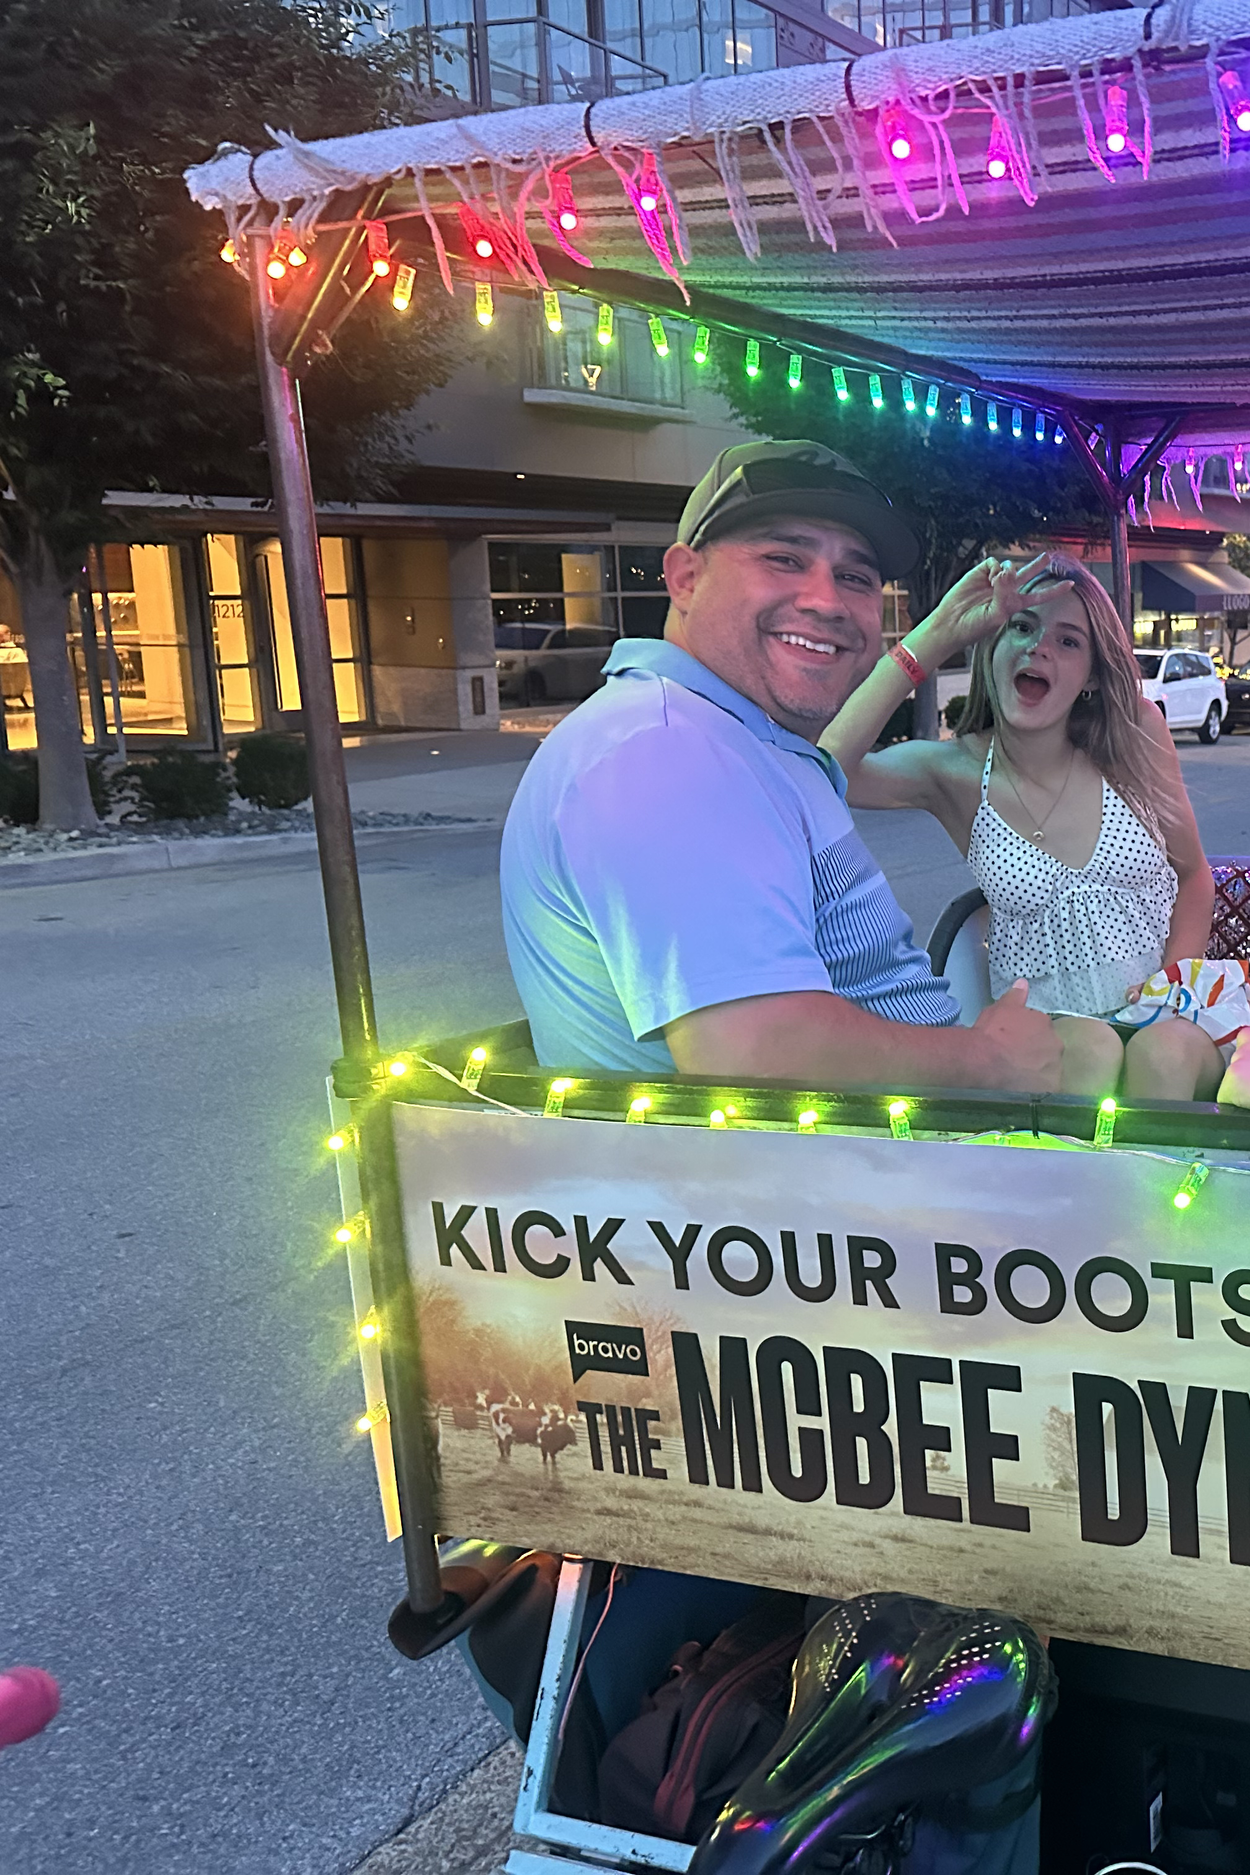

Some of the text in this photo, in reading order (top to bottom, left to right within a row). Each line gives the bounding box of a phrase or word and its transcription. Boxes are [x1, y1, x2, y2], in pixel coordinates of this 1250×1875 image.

[430, 1201, 635, 1286] KICK
[645, 1220, 901, 1310] YOUR
[573, 1332, 642, 1361] bravo
[577, 1401, 668, 1480] THE
[670, 1330, 1031, 1533] MCBEE
